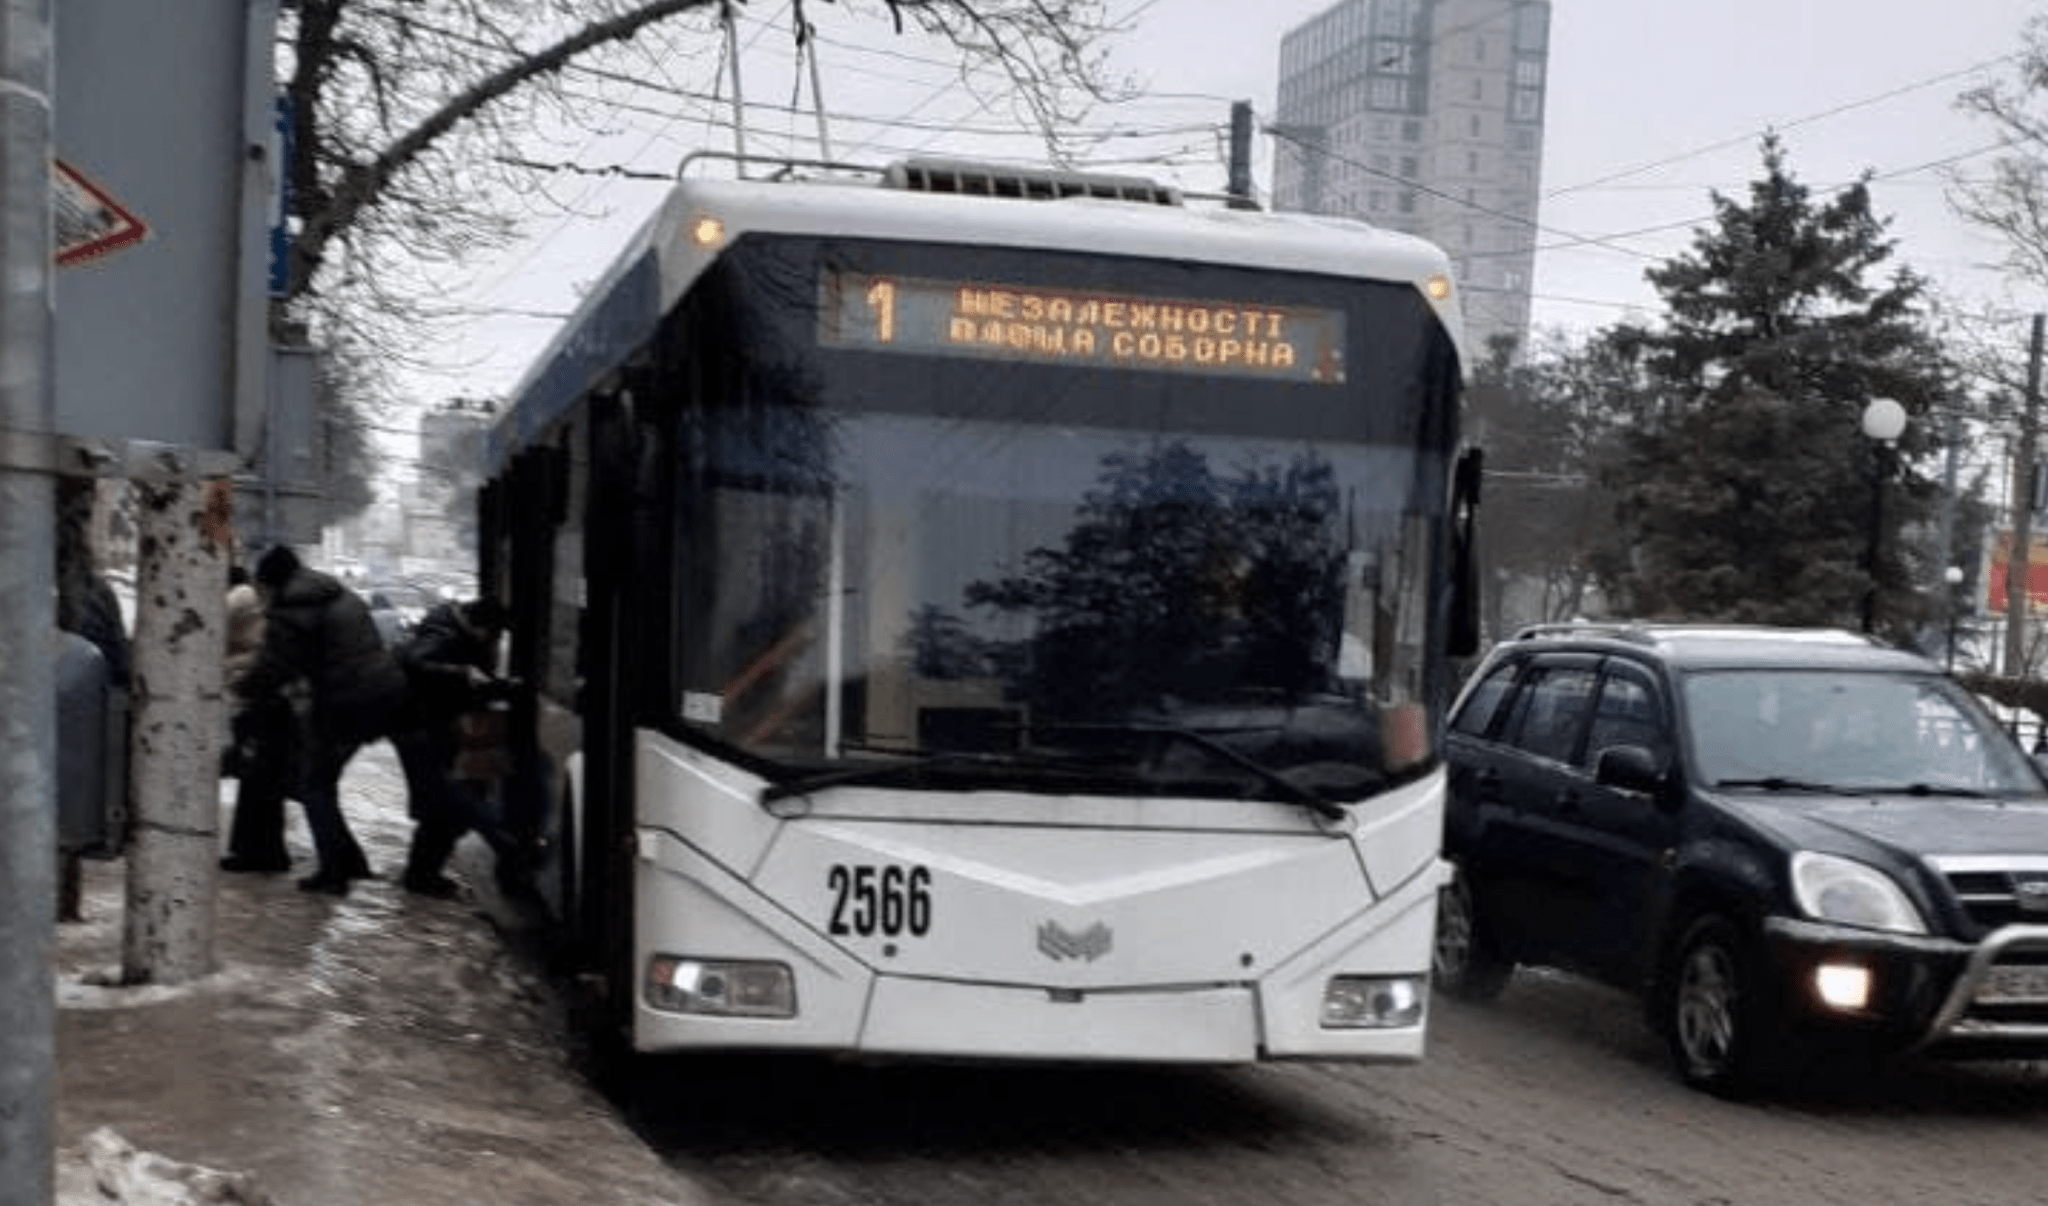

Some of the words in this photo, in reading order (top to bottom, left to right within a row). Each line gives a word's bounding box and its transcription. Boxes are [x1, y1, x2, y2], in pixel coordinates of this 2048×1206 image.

[867, 281, 895, 343] 1
[1113, 330, 1295, 368] СОБОРНА
[827, 863, 931, 938] 2566
